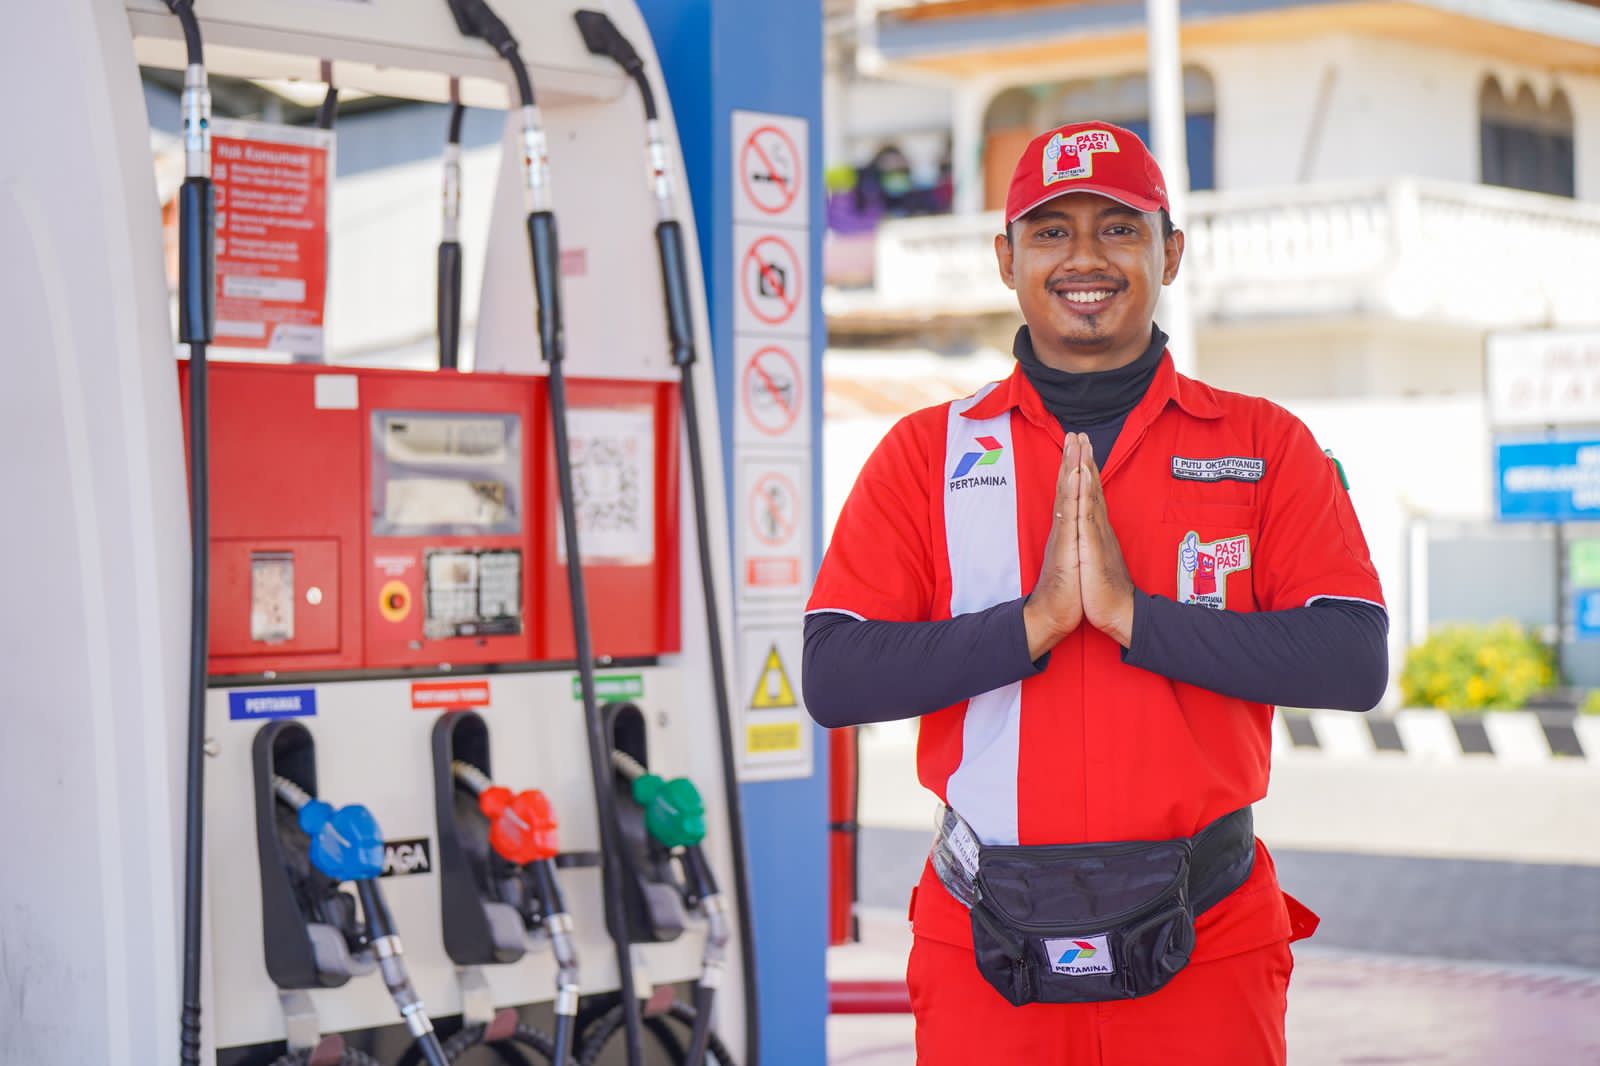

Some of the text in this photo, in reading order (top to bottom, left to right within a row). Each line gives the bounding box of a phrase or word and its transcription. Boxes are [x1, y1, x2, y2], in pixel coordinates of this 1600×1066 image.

[1076, 133, 1109, 145] PASTI
[1181, 460, 1202, 470] PUTU
[1205, 459, 1261, 470] OKTAFIYANUS
[950, 476, 1007, 492] PERTAMINA
[1215, 540, 1245, 557] PASTI
[383, 843, 429, 874] AGA
[1055, 965, 1109, 974] PERTAMINA
